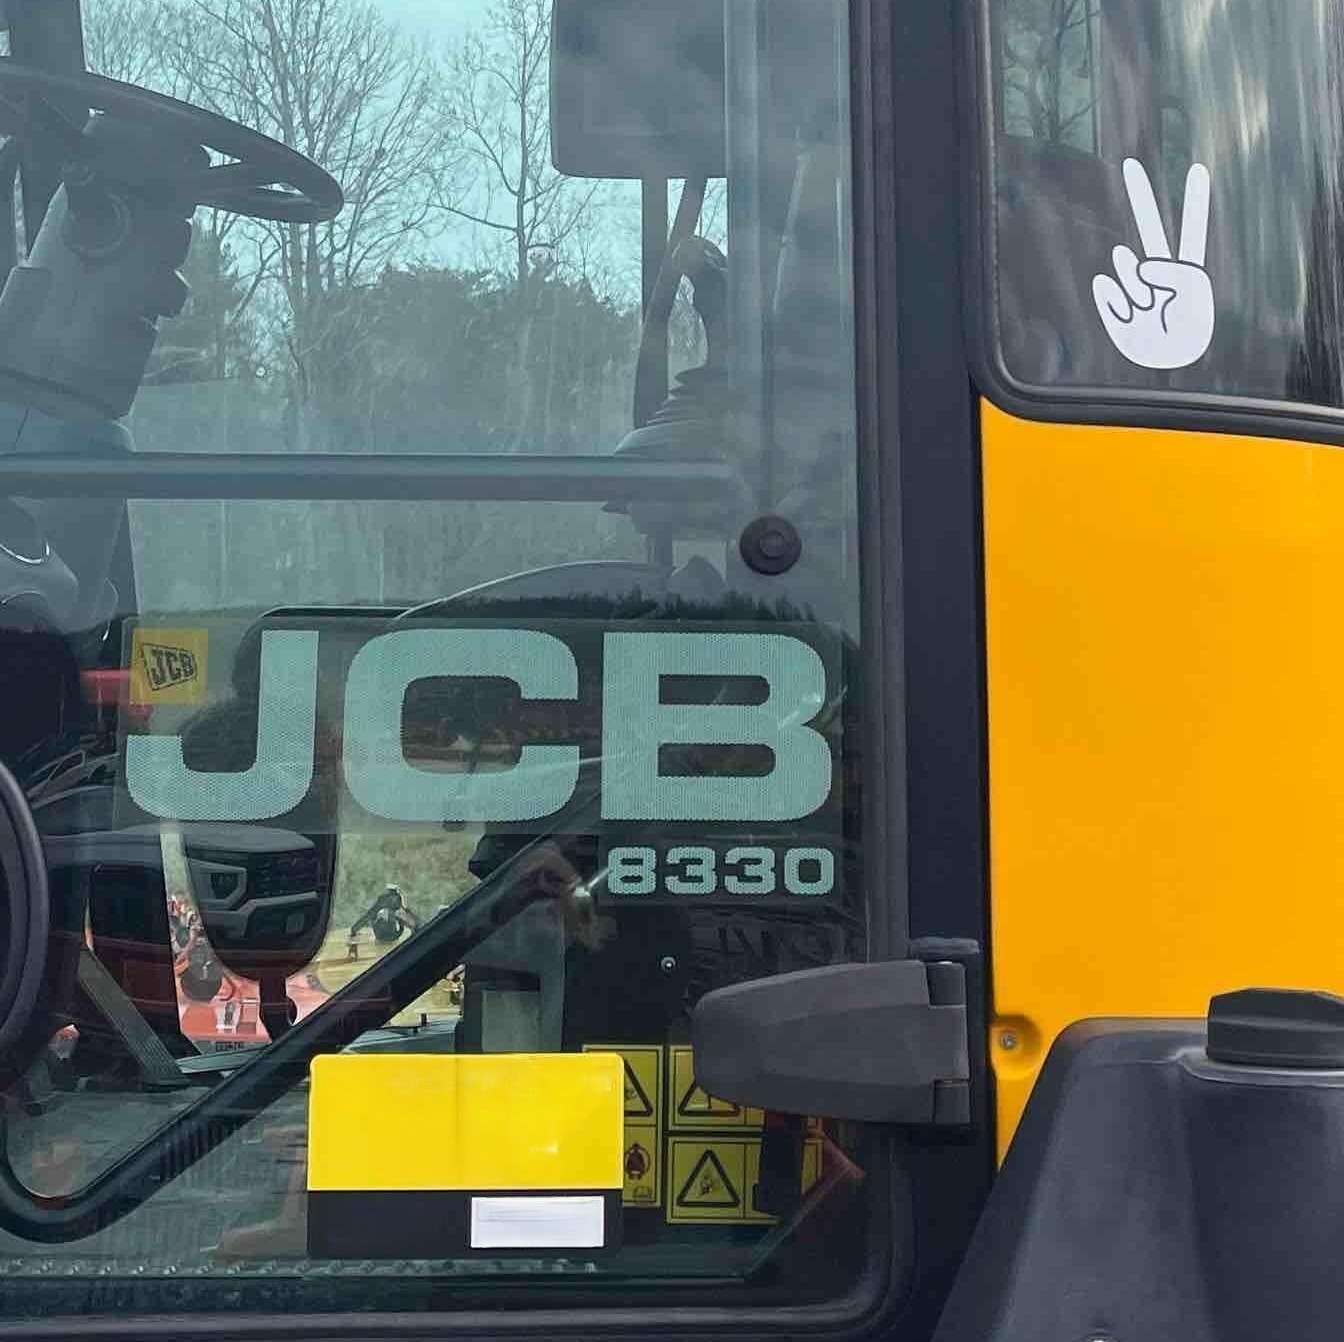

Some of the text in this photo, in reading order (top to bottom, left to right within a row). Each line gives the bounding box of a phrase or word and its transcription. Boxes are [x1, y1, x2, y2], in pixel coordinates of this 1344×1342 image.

[150, 648, 195, 686] JCB
[125, 627, 832, 822] JCB
[607, 846, 834, 895] 8330
